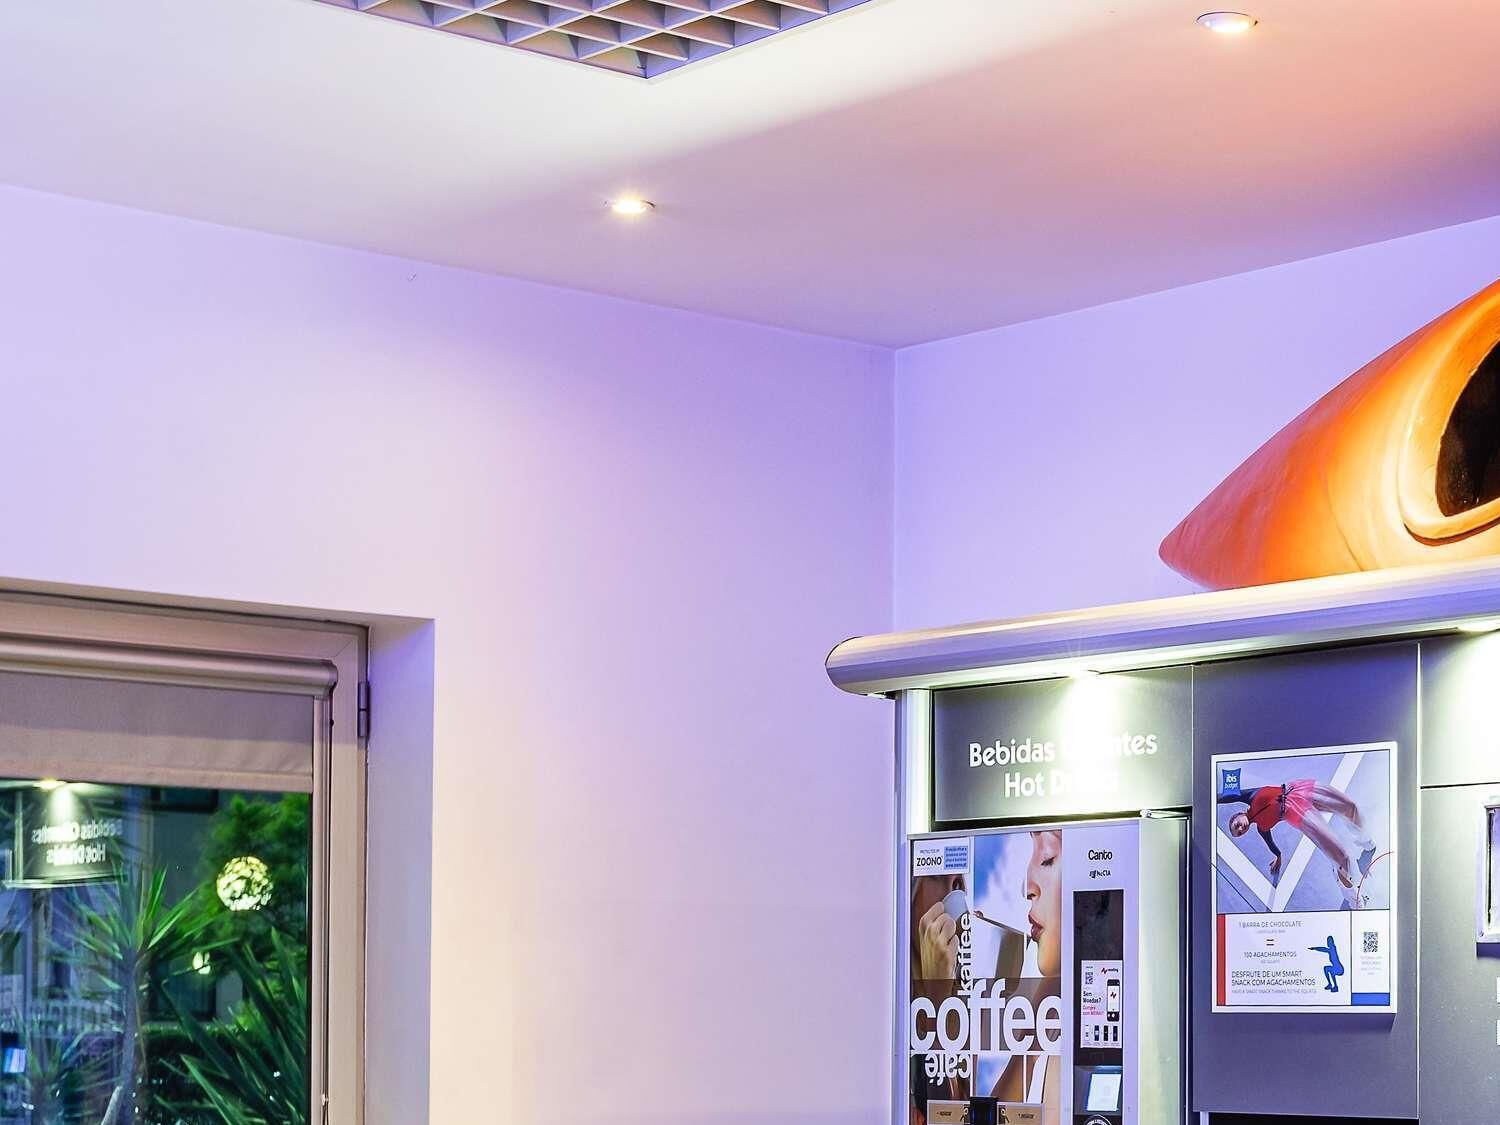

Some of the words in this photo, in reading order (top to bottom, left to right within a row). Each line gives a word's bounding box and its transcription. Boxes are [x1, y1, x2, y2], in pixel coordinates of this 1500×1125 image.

[969, 738, 1055, 768] Bebidas
[1004, 772, 1045, 798] Hot
[1088, 849, 1113, 861] Canto
[917, 856, 942, 867] ZOONO
[1270, 920, 1302, 928] CHOCOLATE
[957, 912, 972, 996] kaffee
[1253, 950, 1297, 958] AGACHAMENTOS
[1232, 970, 1261, 978] DESFRUTE
[1262, 970, 1271, 978] DE
[1272, 970, 1282, 978] UM
[1282, 970, 1302, 978] SMART
[1232, 979, 1252, 987] SNACK
[1266, 978, 1316, 986] AGACHAMENTOS
[911, 978, 1062, 1053] coffee
[925, 1053, 971, 1086] café
